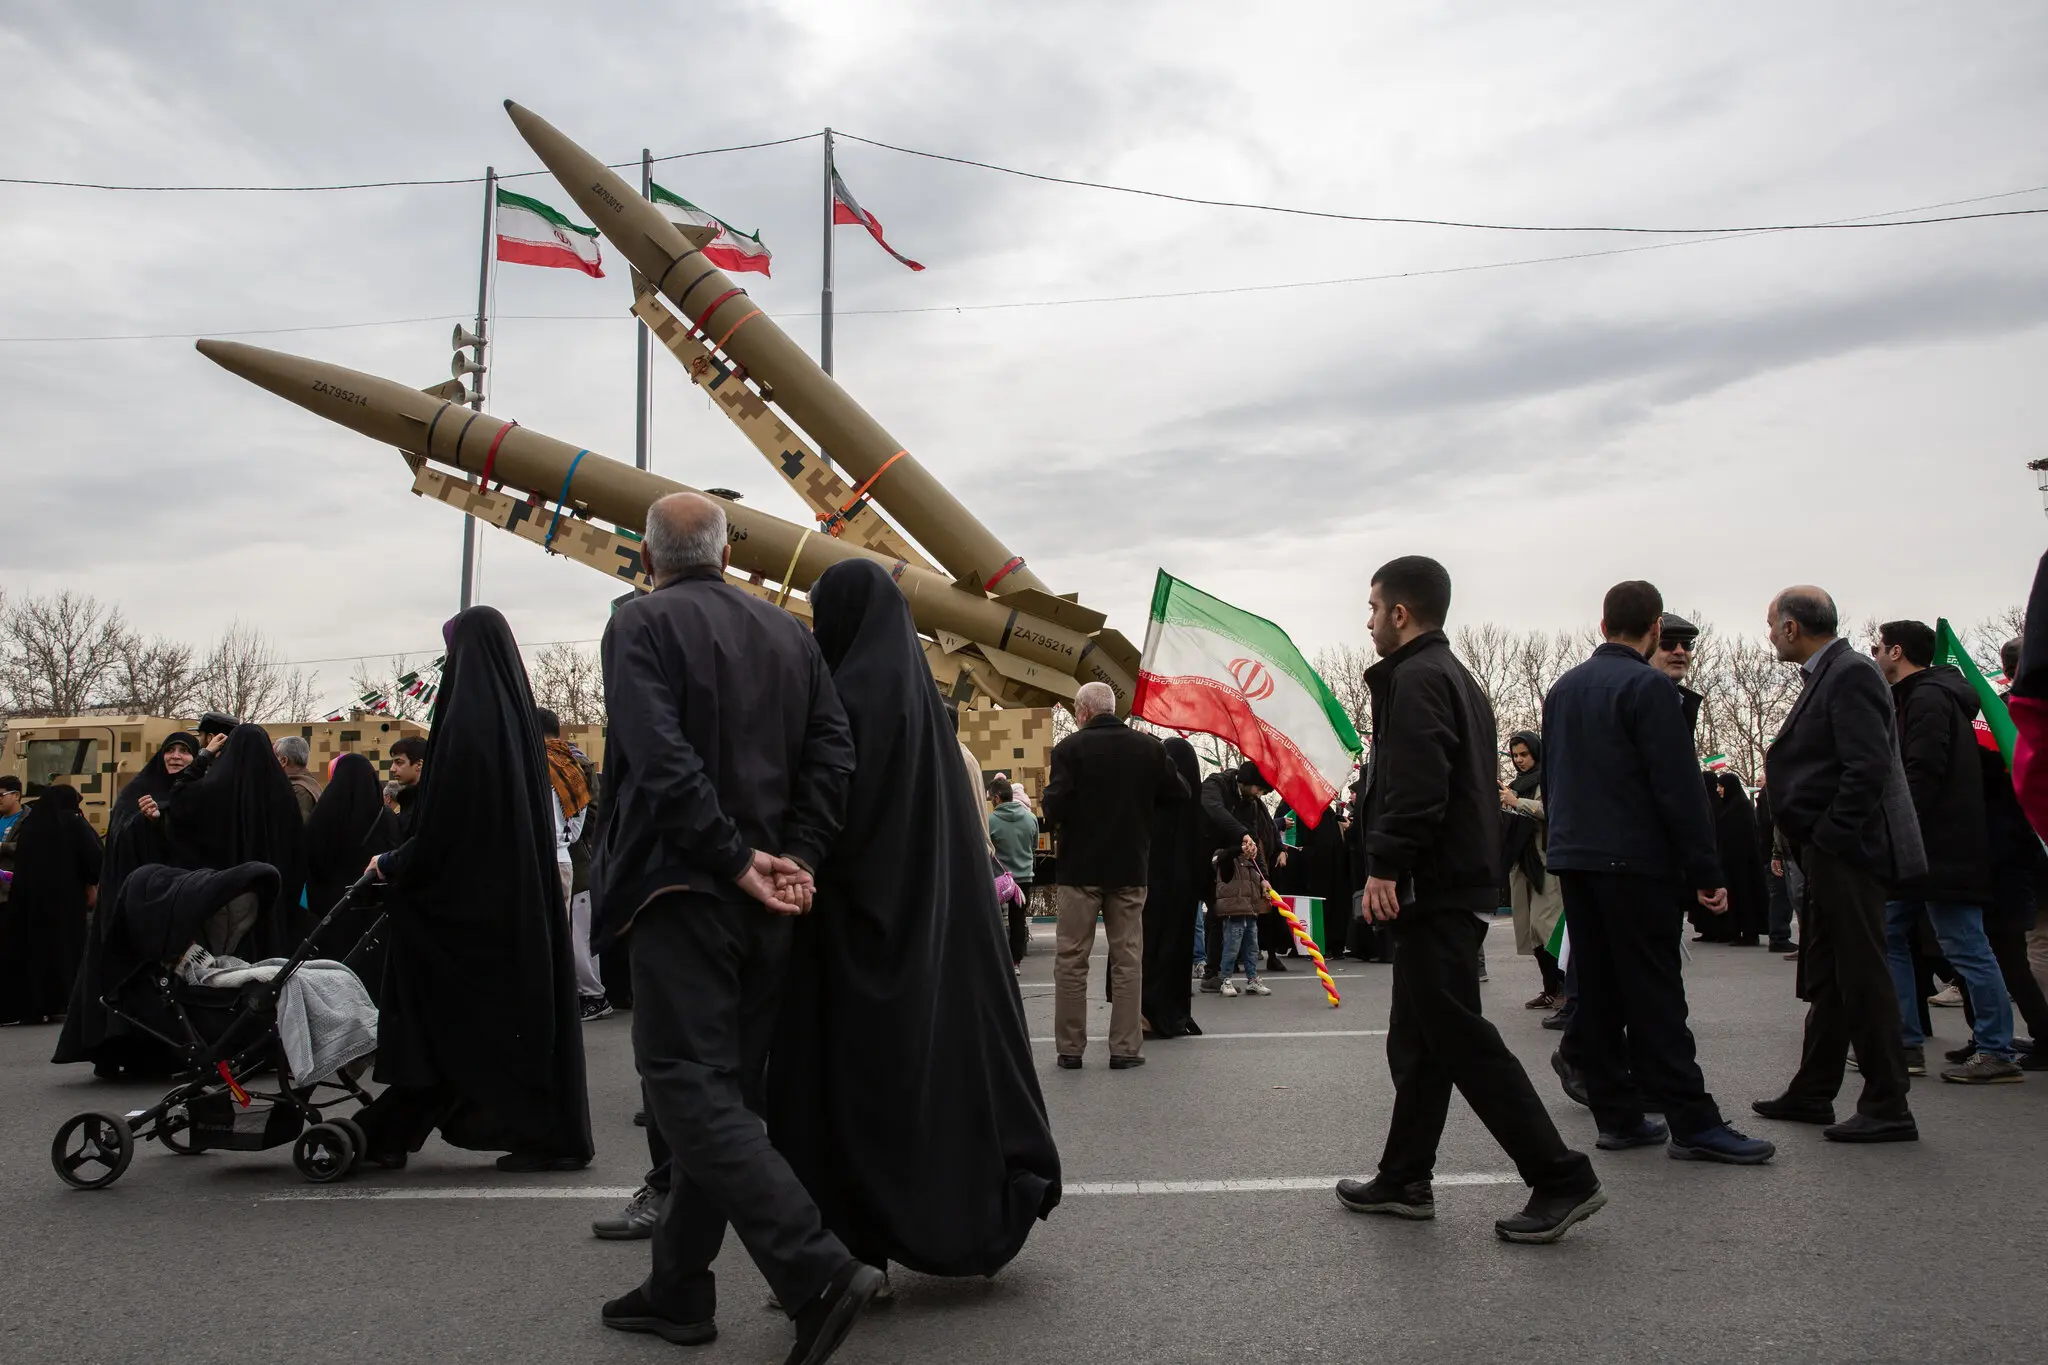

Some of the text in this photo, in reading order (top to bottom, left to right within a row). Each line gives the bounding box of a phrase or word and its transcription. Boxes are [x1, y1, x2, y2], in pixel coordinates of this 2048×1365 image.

[591, 182, 625, 214] ZA793015
[312, 380, 368, 407] ZA795214
[1014, 626, 1073, 656] ZA795214
